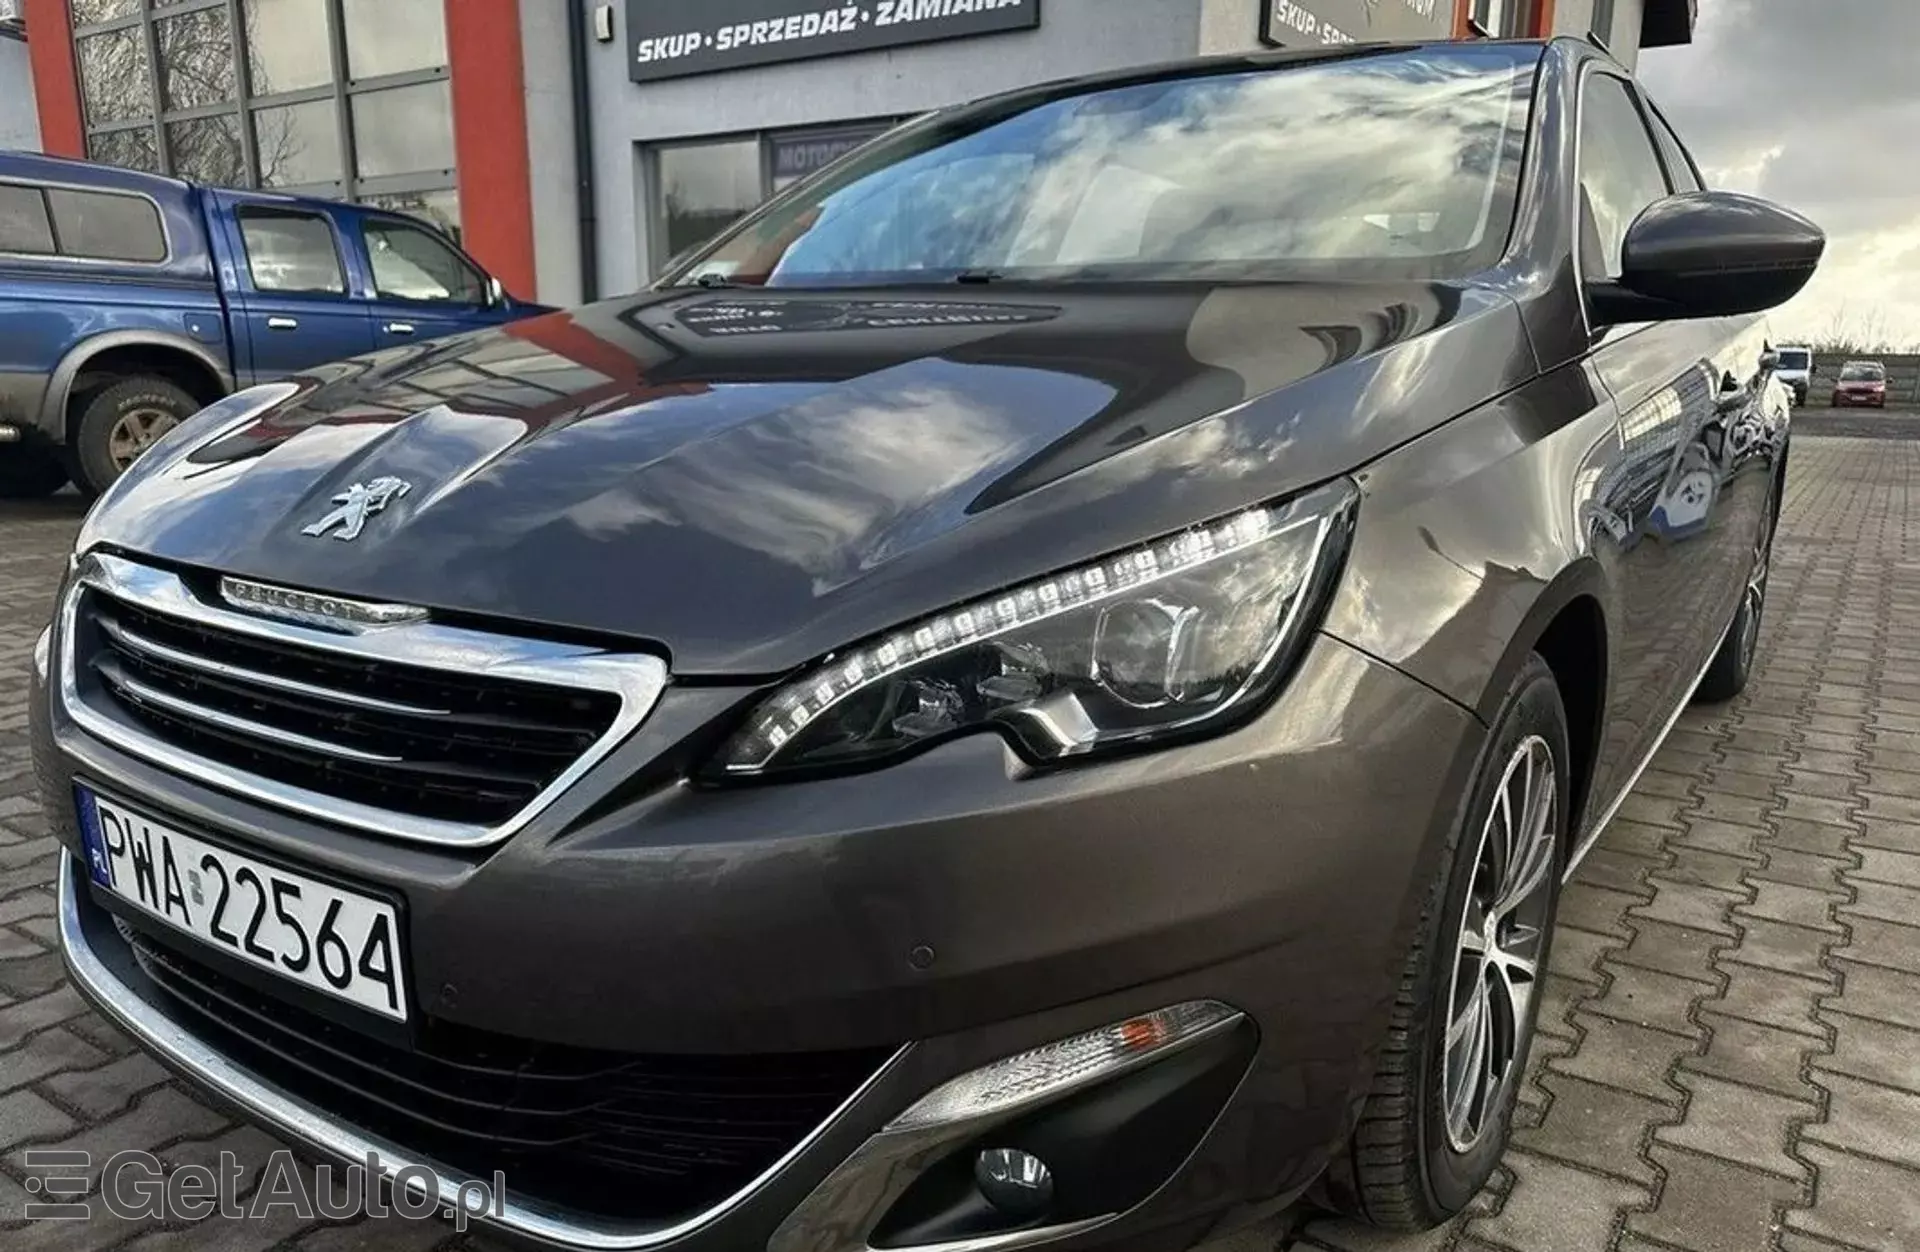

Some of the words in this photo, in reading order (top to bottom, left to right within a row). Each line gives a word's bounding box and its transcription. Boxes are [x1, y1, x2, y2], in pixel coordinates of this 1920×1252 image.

[637, 31, 702, 63] SKUP
[715, 1, 859, 51] SPRZEDAŻ
[1276, 0, 1317, 35] SKUP
[99, 806, 193, 927] PWA
[200, 853, 400, 1011] 22564
